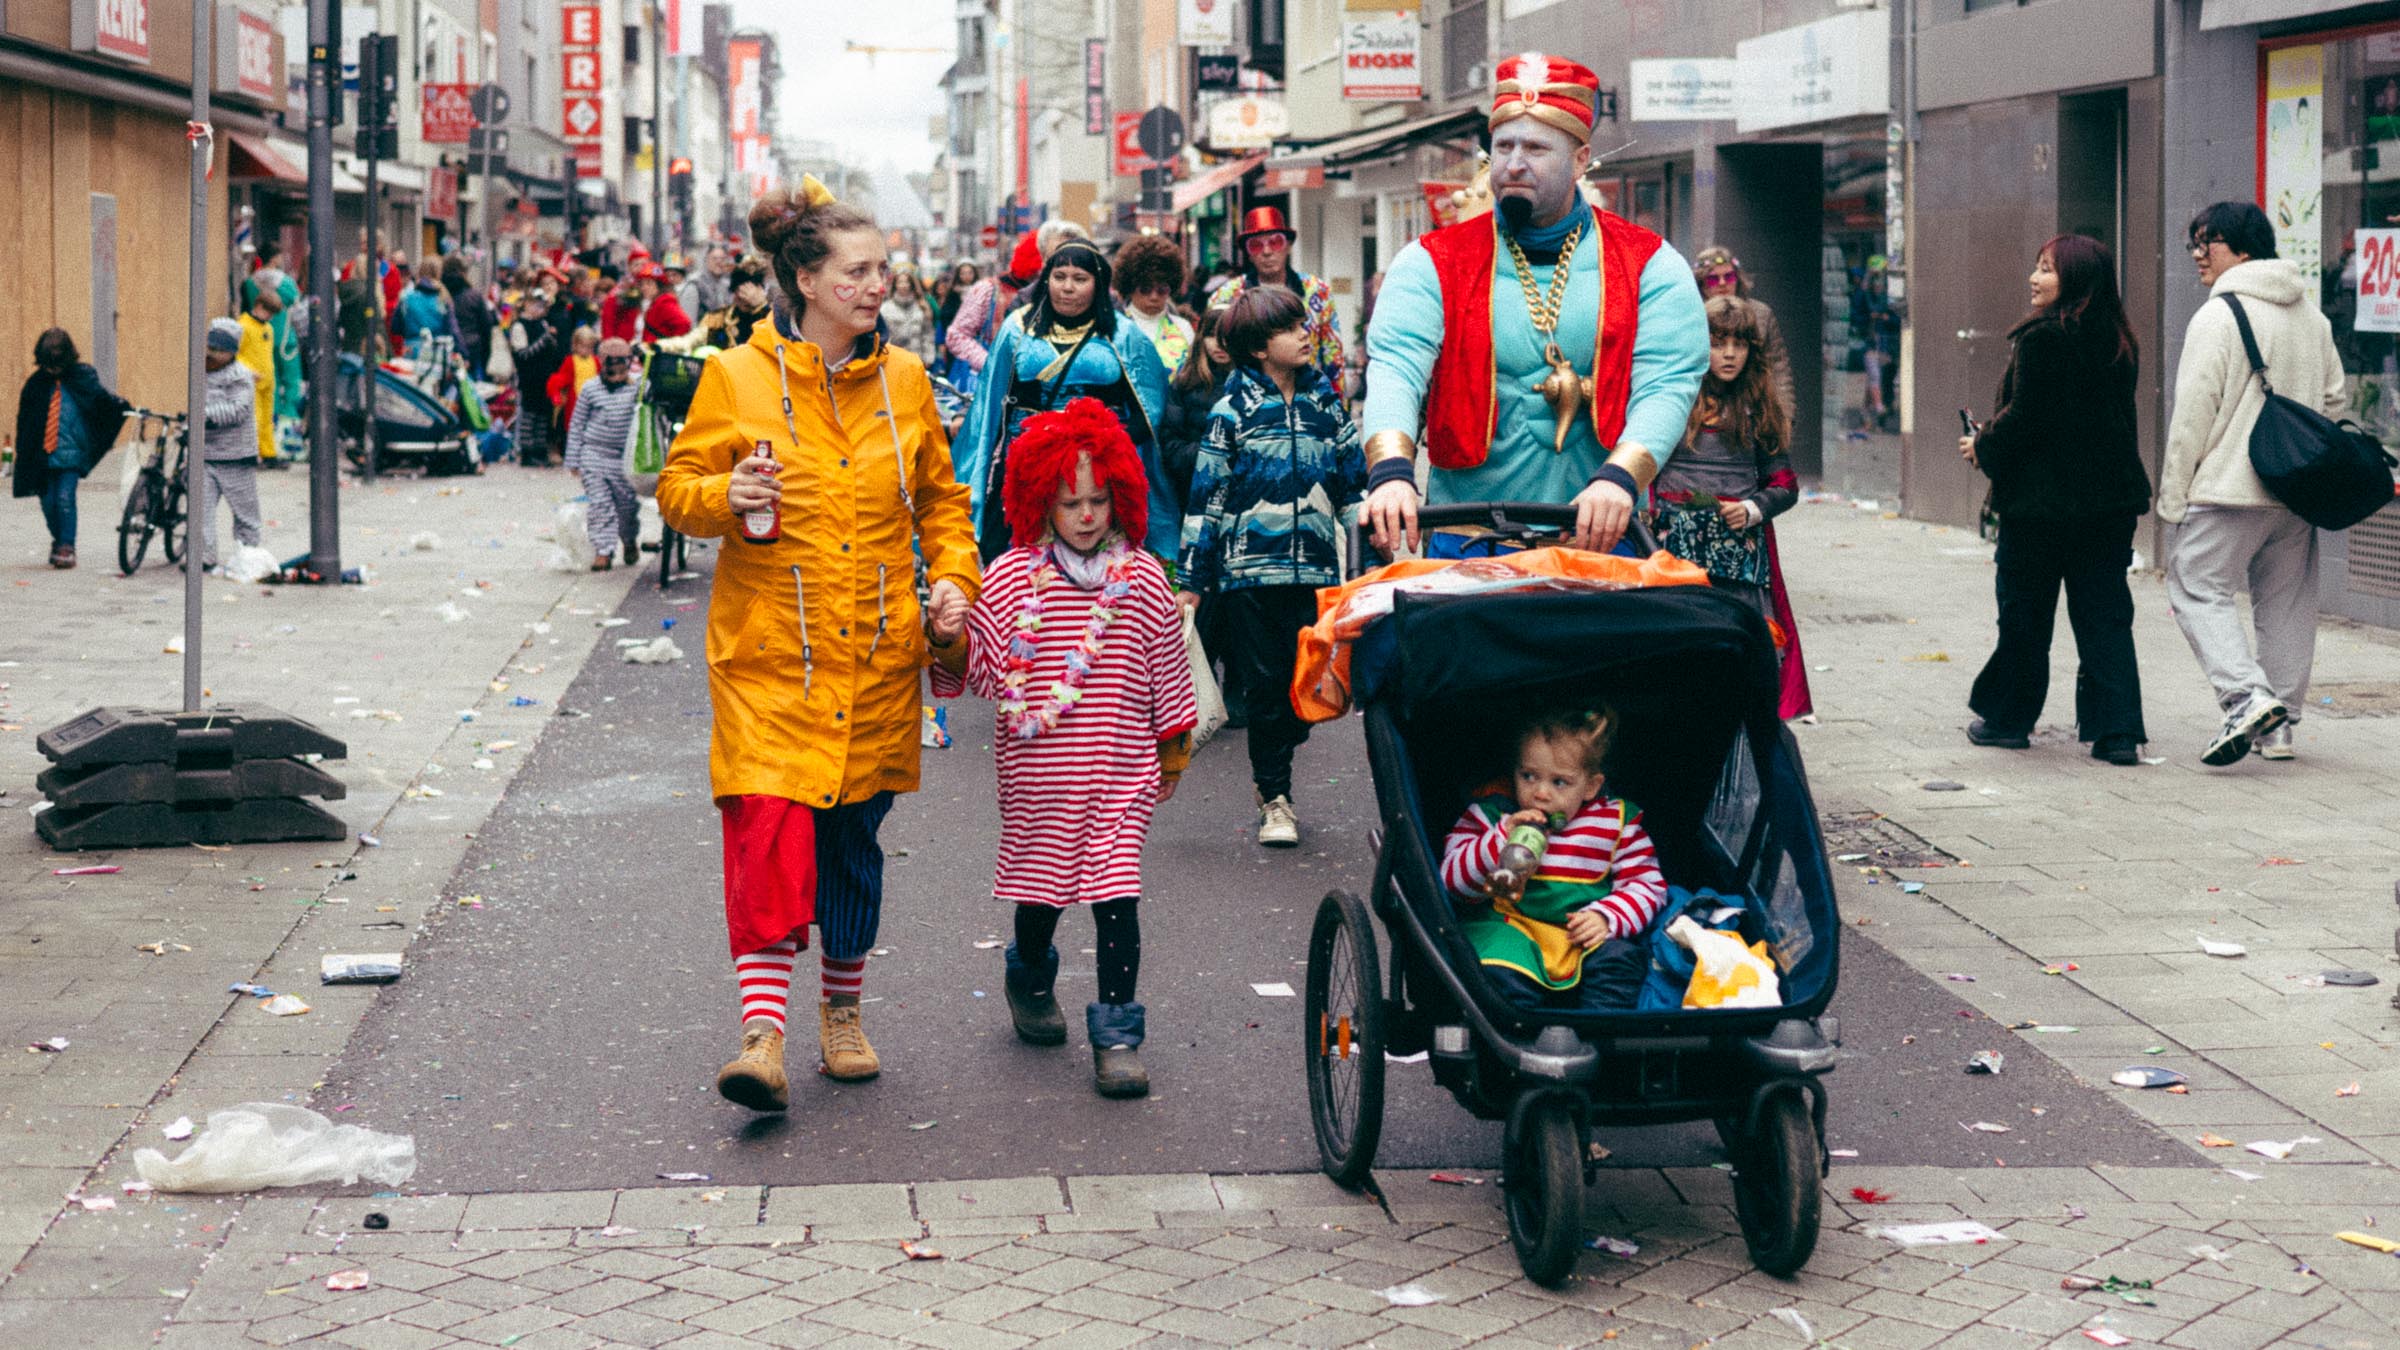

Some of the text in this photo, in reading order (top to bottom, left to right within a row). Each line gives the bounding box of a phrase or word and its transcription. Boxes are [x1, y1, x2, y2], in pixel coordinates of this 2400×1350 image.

[1348, 52, 1415, 69] KIOSK
[1202, 62, 1235, 82] sky
[2360, 236, 2400, 299] 20
